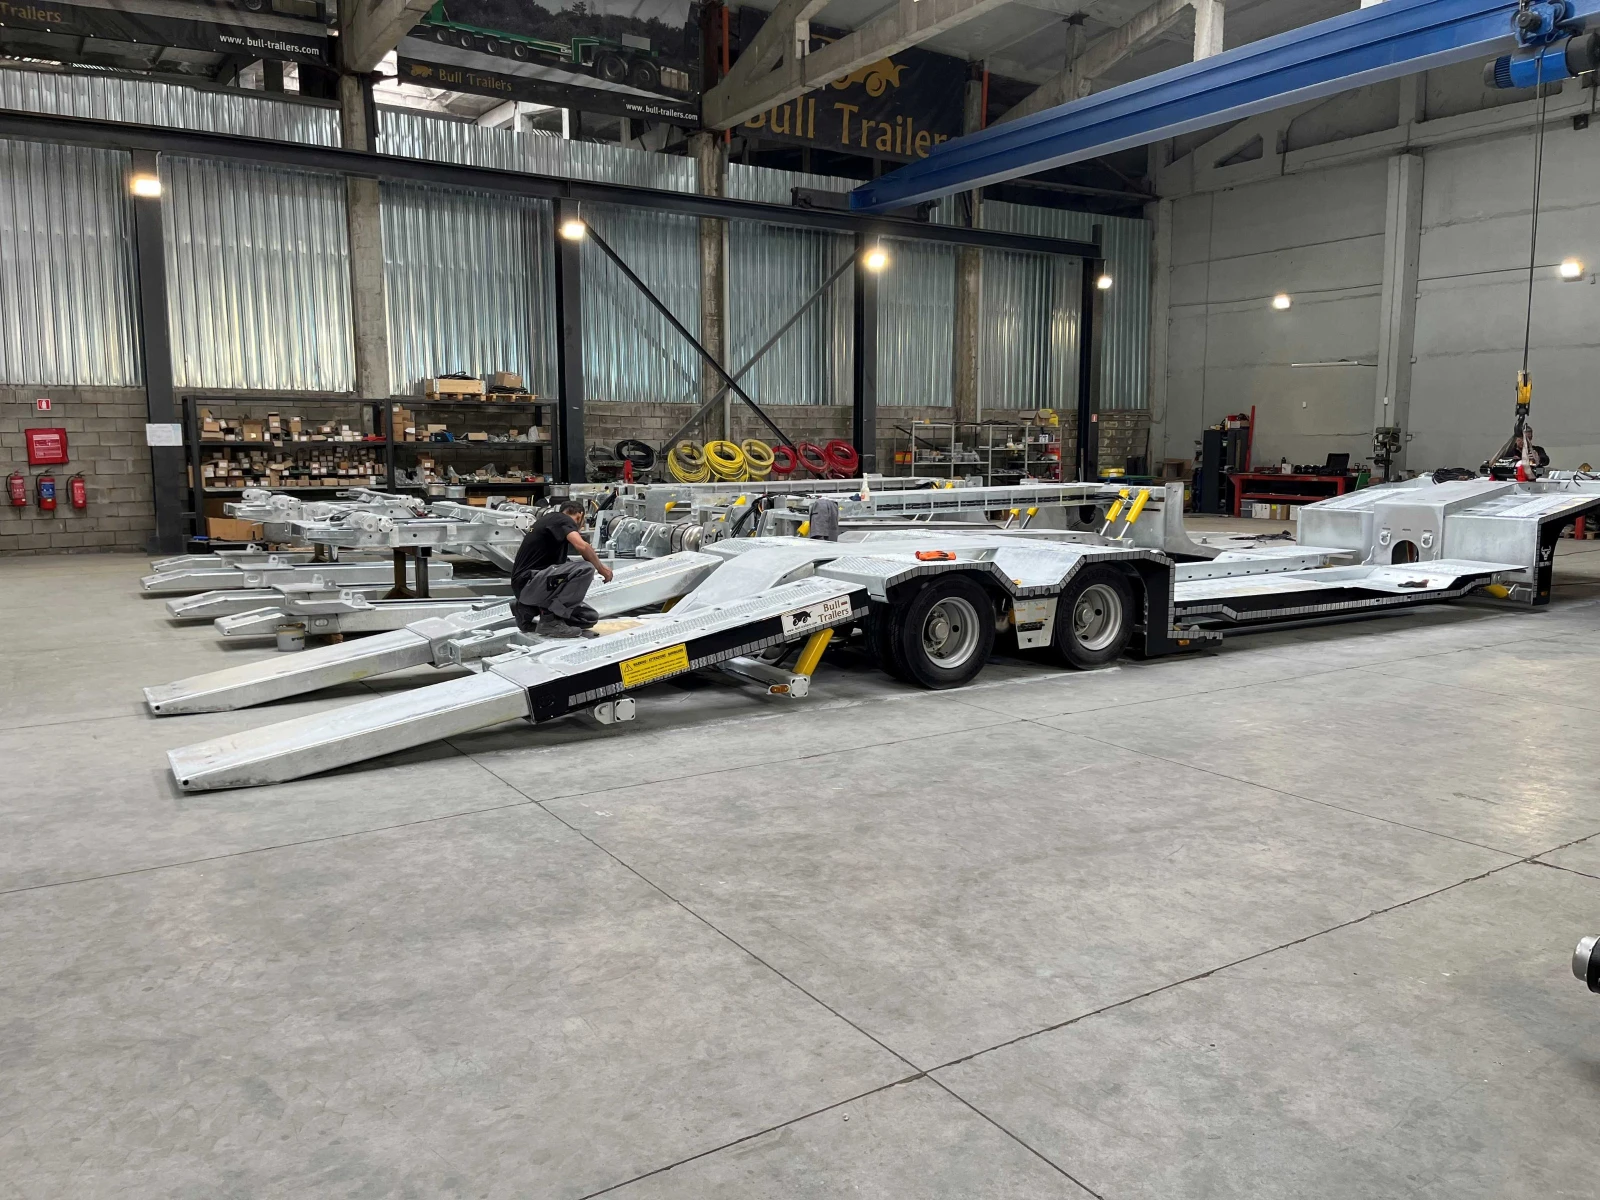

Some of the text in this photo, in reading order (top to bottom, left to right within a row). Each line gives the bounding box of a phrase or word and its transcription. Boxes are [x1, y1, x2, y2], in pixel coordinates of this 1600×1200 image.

[0, 1, 61, 23] Trailers
[219, 34, 320, 56] www. bull-trailers.com
[439, 68, 512, 92] Bull Trailers
[625, 103, 698, 121] www. bull-trailers.com
[818, 608, 849, 623] Trailers
[823, 600, 840, 612] Bull
